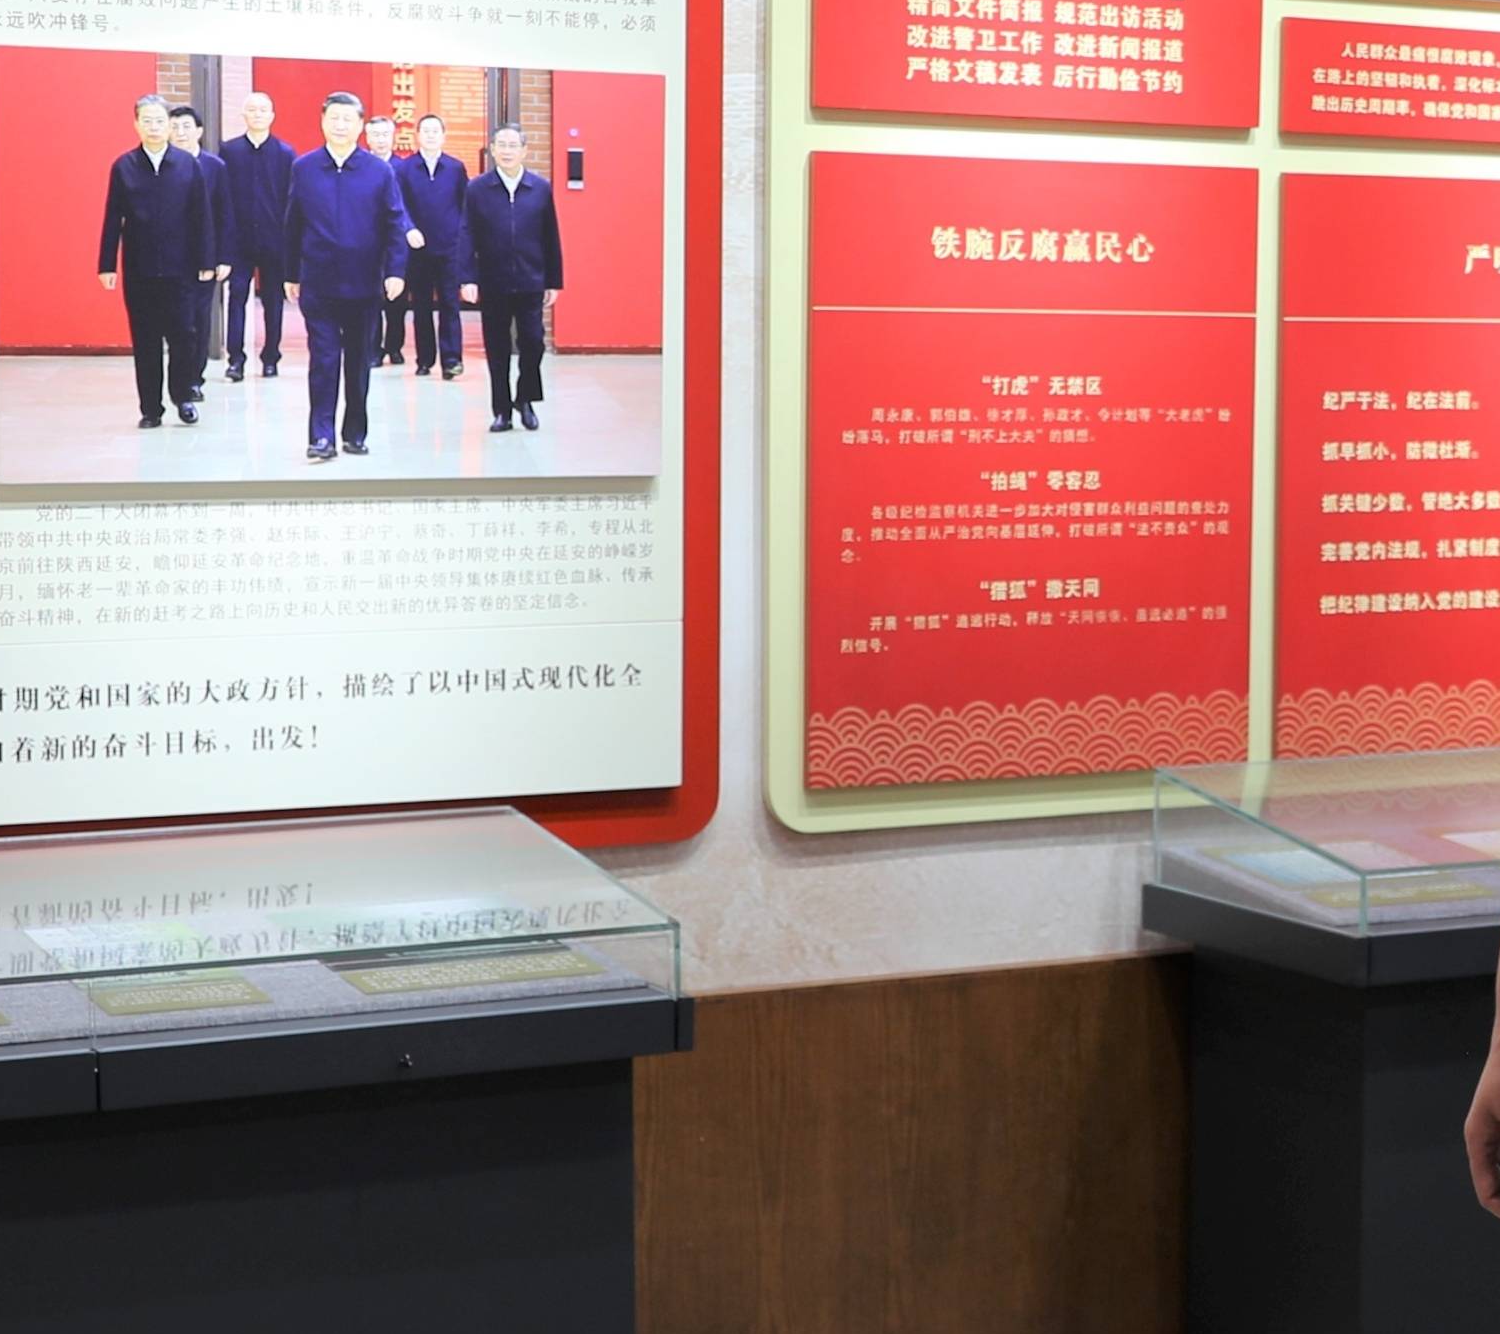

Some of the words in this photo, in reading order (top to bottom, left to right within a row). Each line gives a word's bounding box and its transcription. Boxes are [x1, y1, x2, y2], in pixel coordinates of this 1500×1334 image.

[1053, 0, 1184, 32] 规范出访活动
[906, 25, 1044, 55] 改进警卫工作
[1053, 32, 1184, 63] 改进新闻报道
[906, 56, 1043, 87] 严格文稿发表
[1052, 64, 1184, 95] 厉行勤俭节约
[931, 225, 1155, 265] 铁腕反腐赢民心
[981, 375, 1103, 397] “打虎”无禁区
